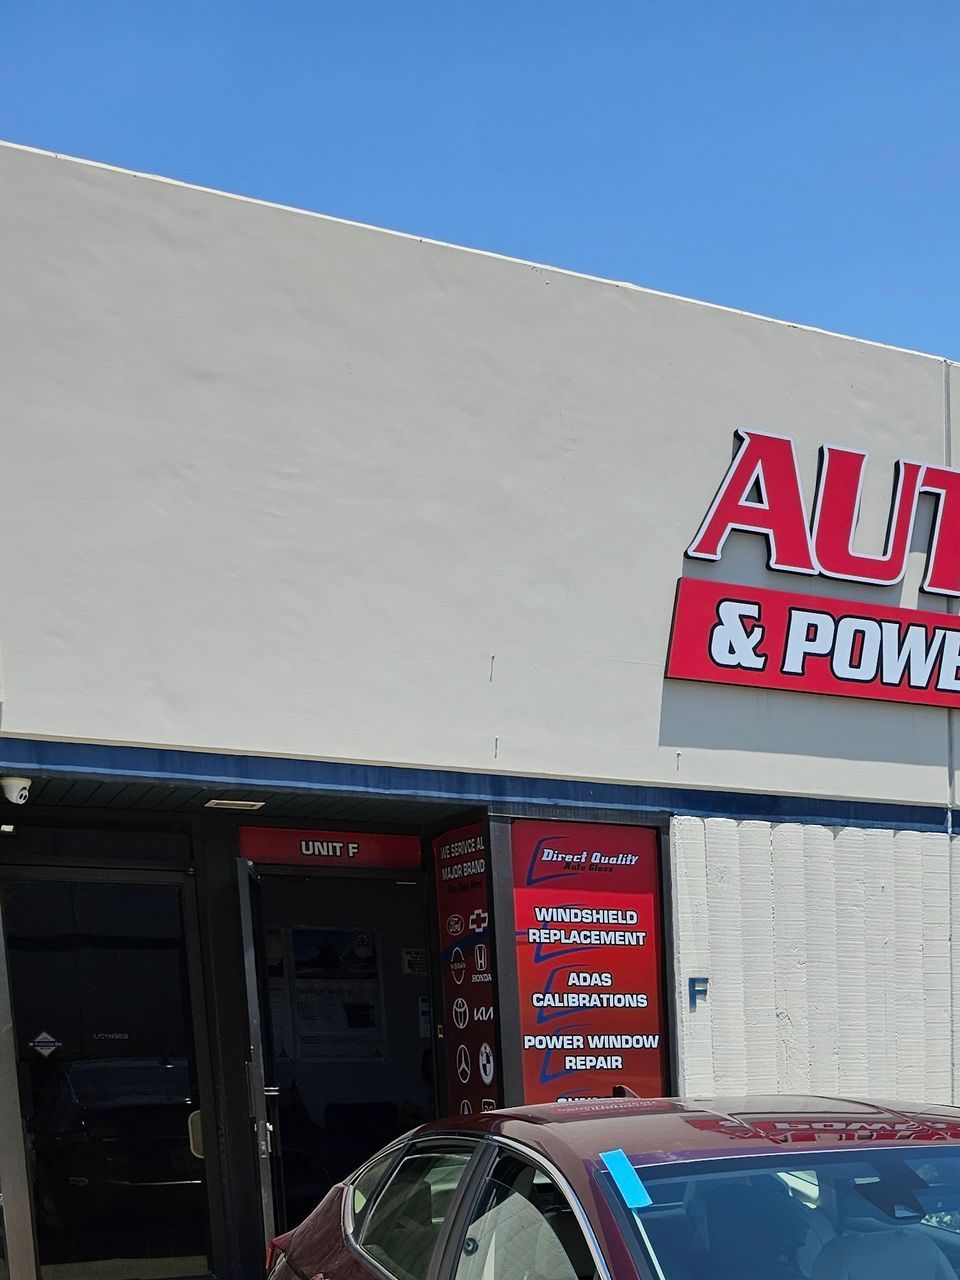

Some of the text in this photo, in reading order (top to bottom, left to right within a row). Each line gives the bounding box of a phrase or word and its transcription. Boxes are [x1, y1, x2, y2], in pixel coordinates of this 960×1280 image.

[709, 600, 767, 671] &
[301, 840, 359, 857] UNIT F
[440, 845, 450, 859] WE
[476, 836, 485, 851] AL
[541, 848, 639, 865] Direct Quality
[442, 859, 485, 881] MAJOR BRAND
[563, 862, 614, 872] Auto Glass
[534, 907, 638, 925] WINDSHIELD
[527, 928, 646, 946] REPLACEMENT
[472, 973, 492, 983] HONDA
[567, 972, 612, 987] ADAS
[532, 994, 648, 1008] CALIBRATIONS
[524, 1034, 660, 1049] POWER WINDOW
[565, 1055, 623, 1070] REPAIR
